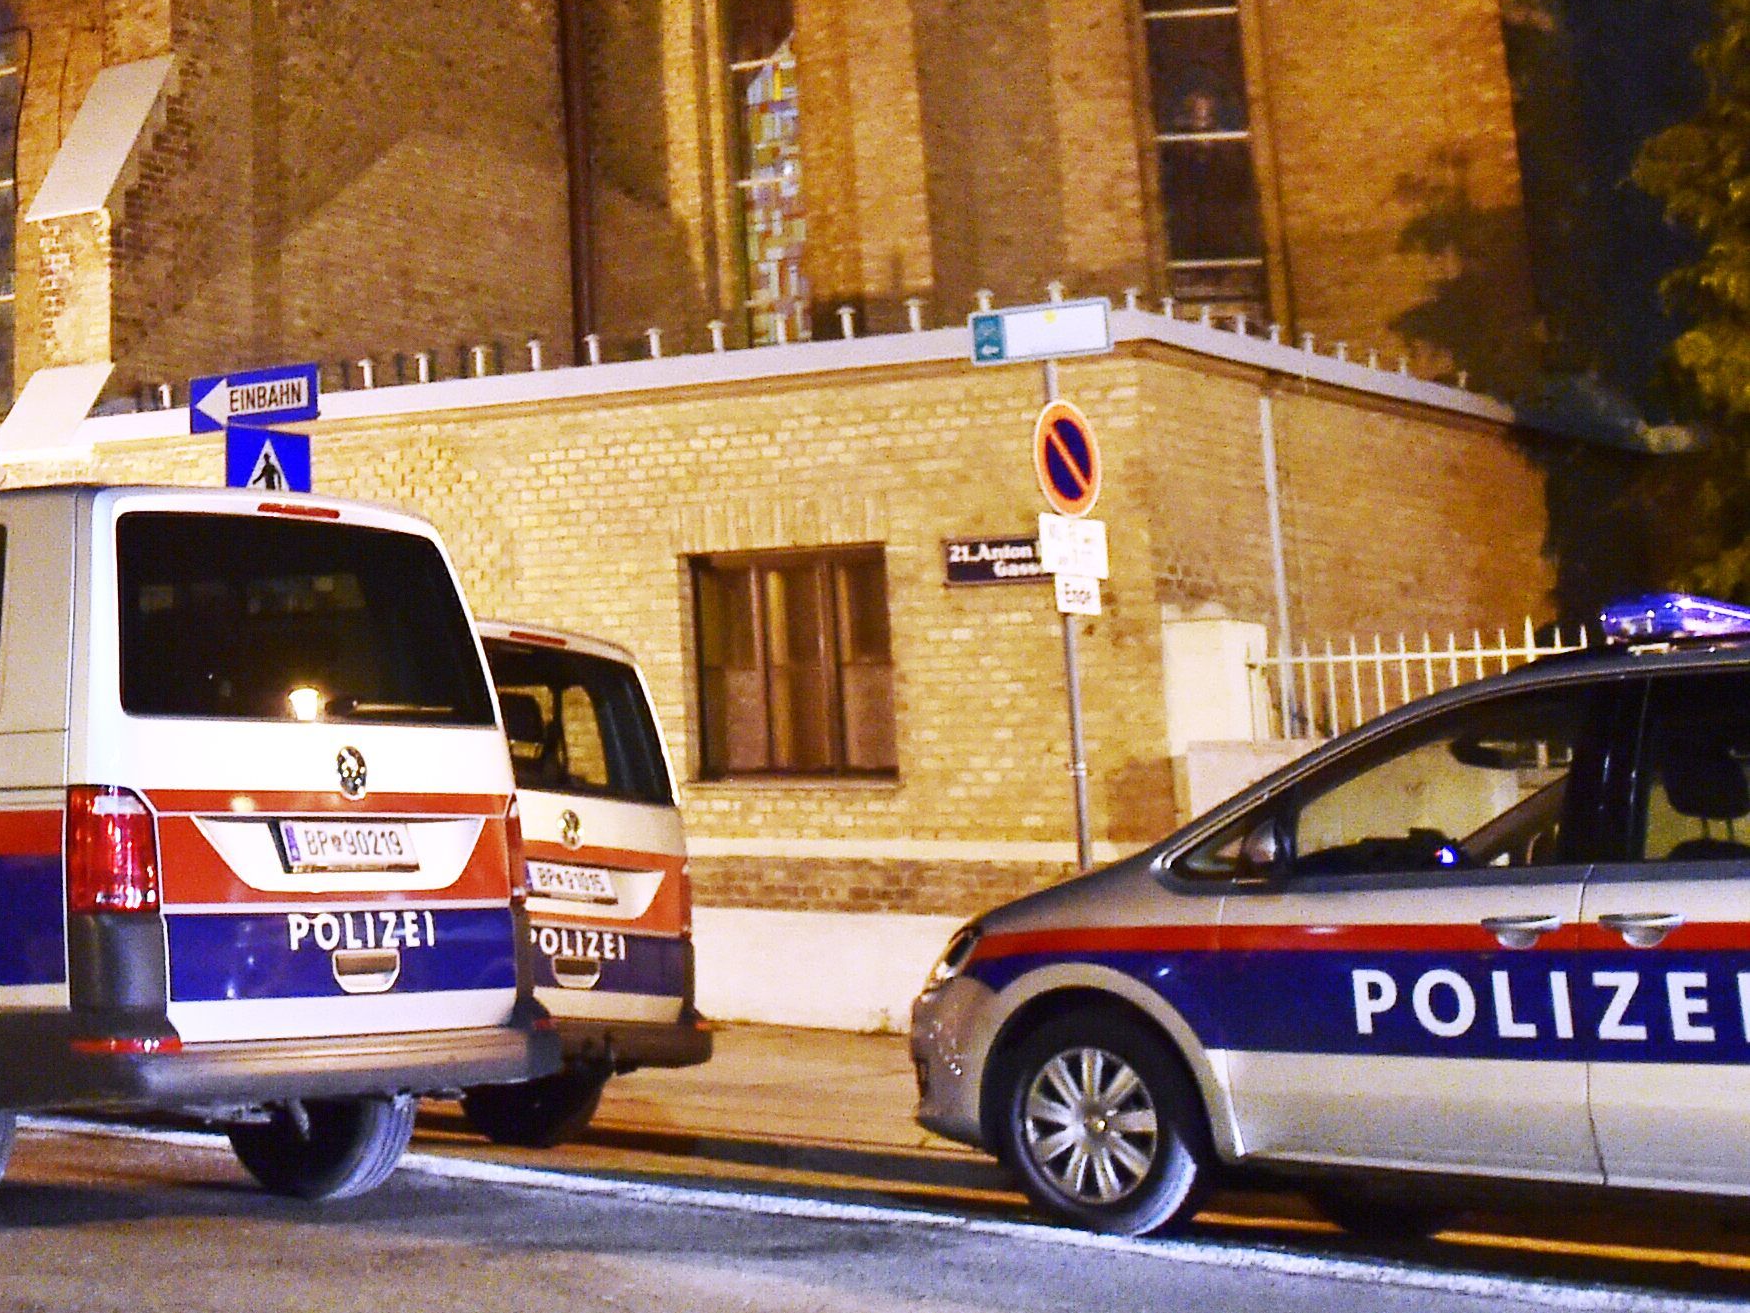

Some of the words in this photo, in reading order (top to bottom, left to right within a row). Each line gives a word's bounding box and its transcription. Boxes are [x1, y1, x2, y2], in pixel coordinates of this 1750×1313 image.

[229, 381, 301, 412] EINBAHN
[304, 830, 328, 856] BP
[343, 830, 403, 856] 90219
[288, 911, 436, 951] POLIZEI
